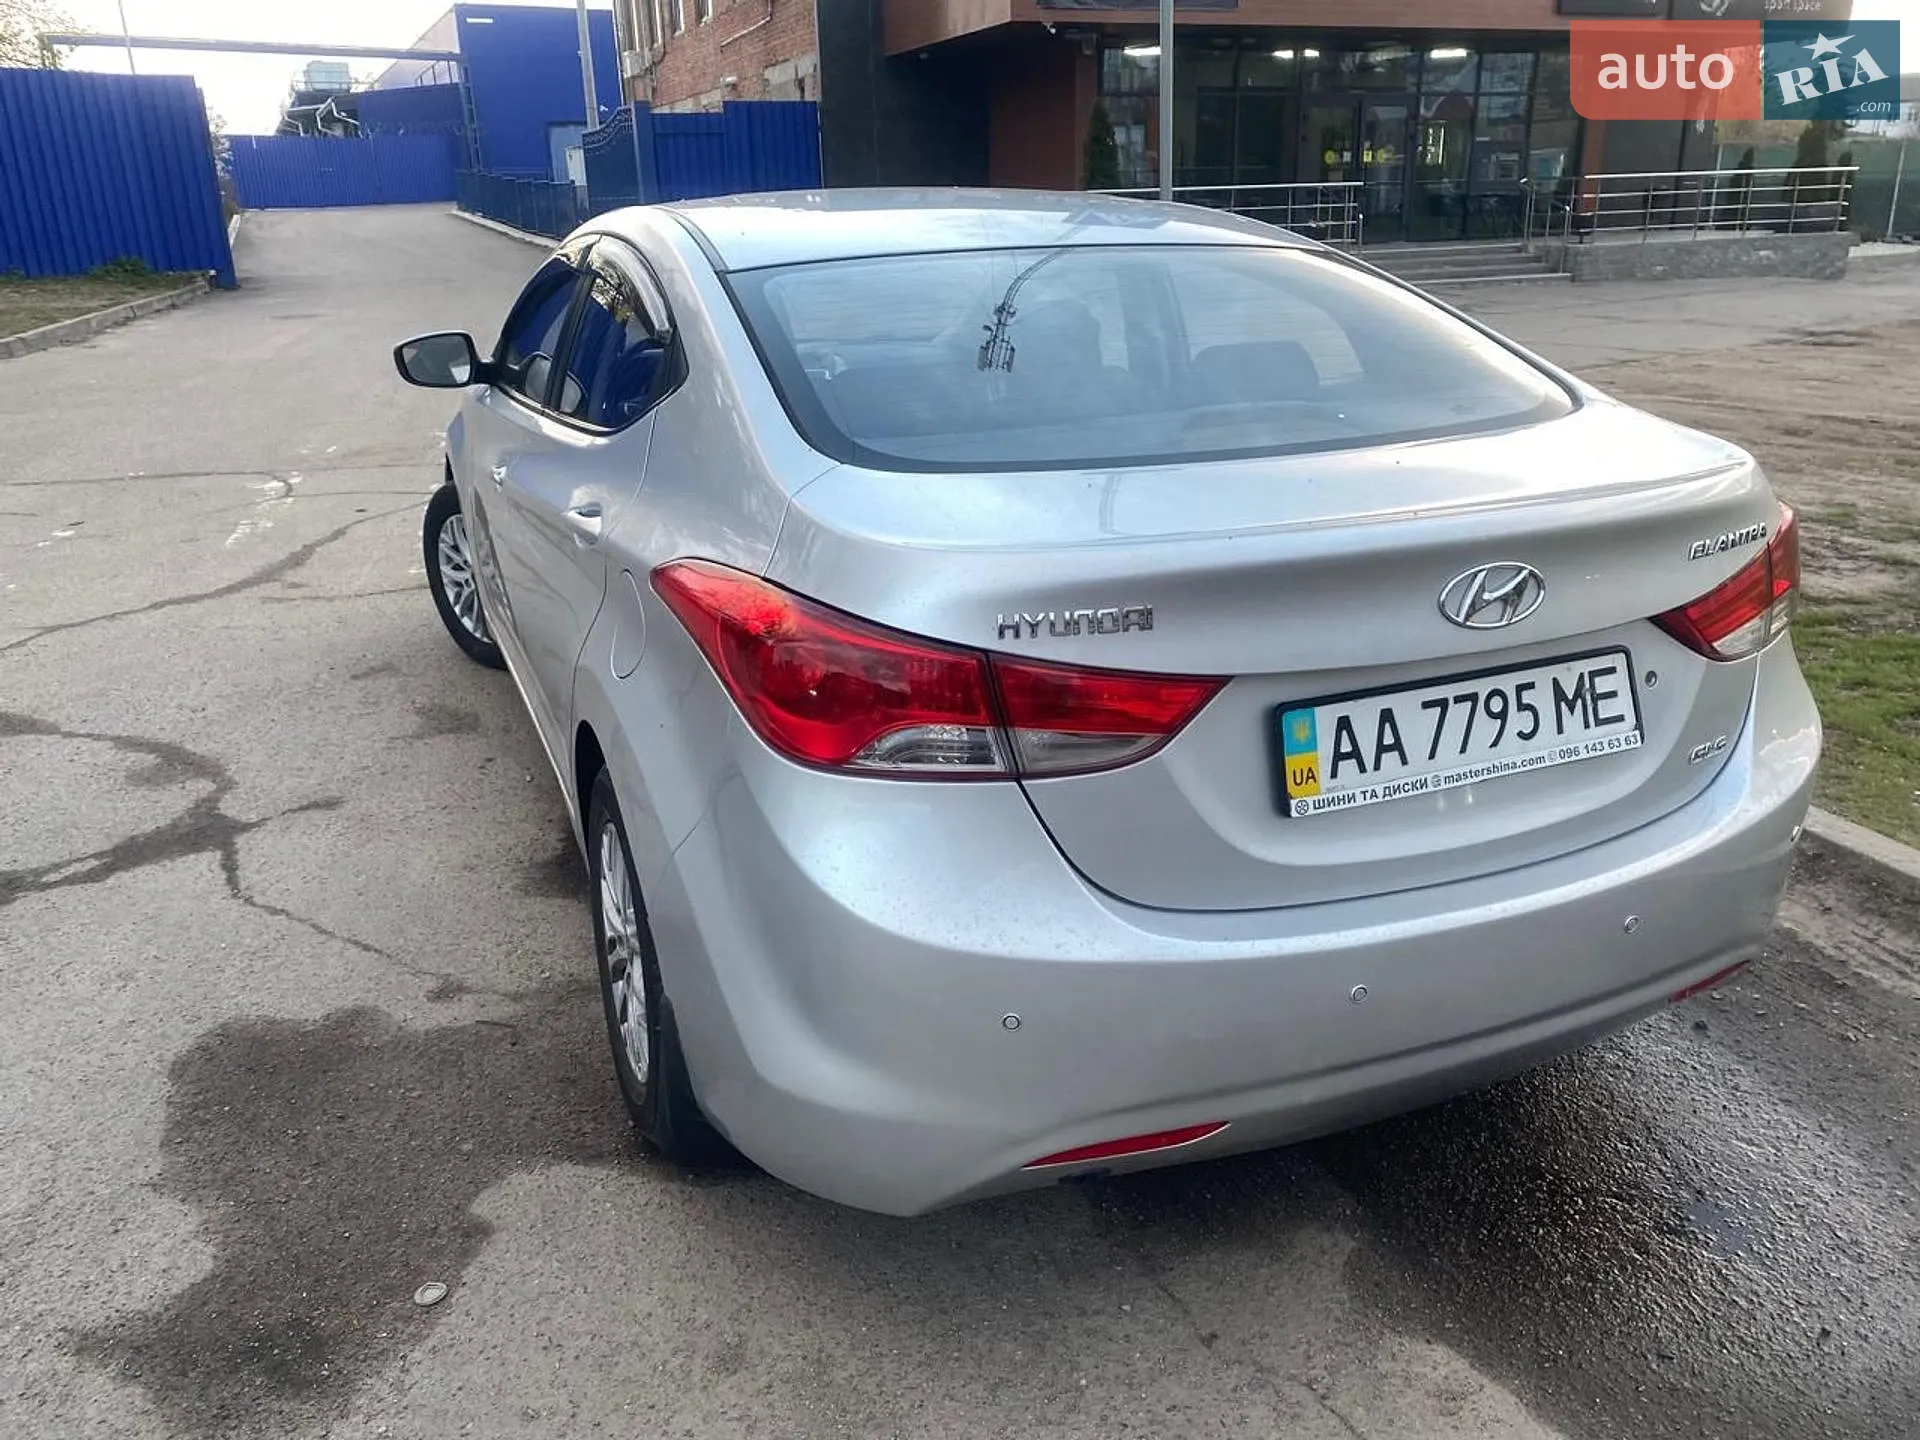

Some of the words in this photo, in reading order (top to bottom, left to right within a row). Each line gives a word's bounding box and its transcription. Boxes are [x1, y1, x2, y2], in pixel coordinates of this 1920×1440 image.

[997, 604, 1153, 640] HYUNDAI
[1330, 707, 1409, 780] AA
[1421, 682, 1541, 761] 7795
[1552, 666, 1626, 735] ME
[1292, 766, 1317, 787] UA
[1313, 793, 1356, 811] ШИНИ
[1382, 778, 1429, 800] ДИСКИ
[1443, 754, 1547, 786] mastershina.com
[1558, 745, 1581, 760] 096
[1584, 740, 1605, 755] 143
[1607, 736, 1622, 750] 63
